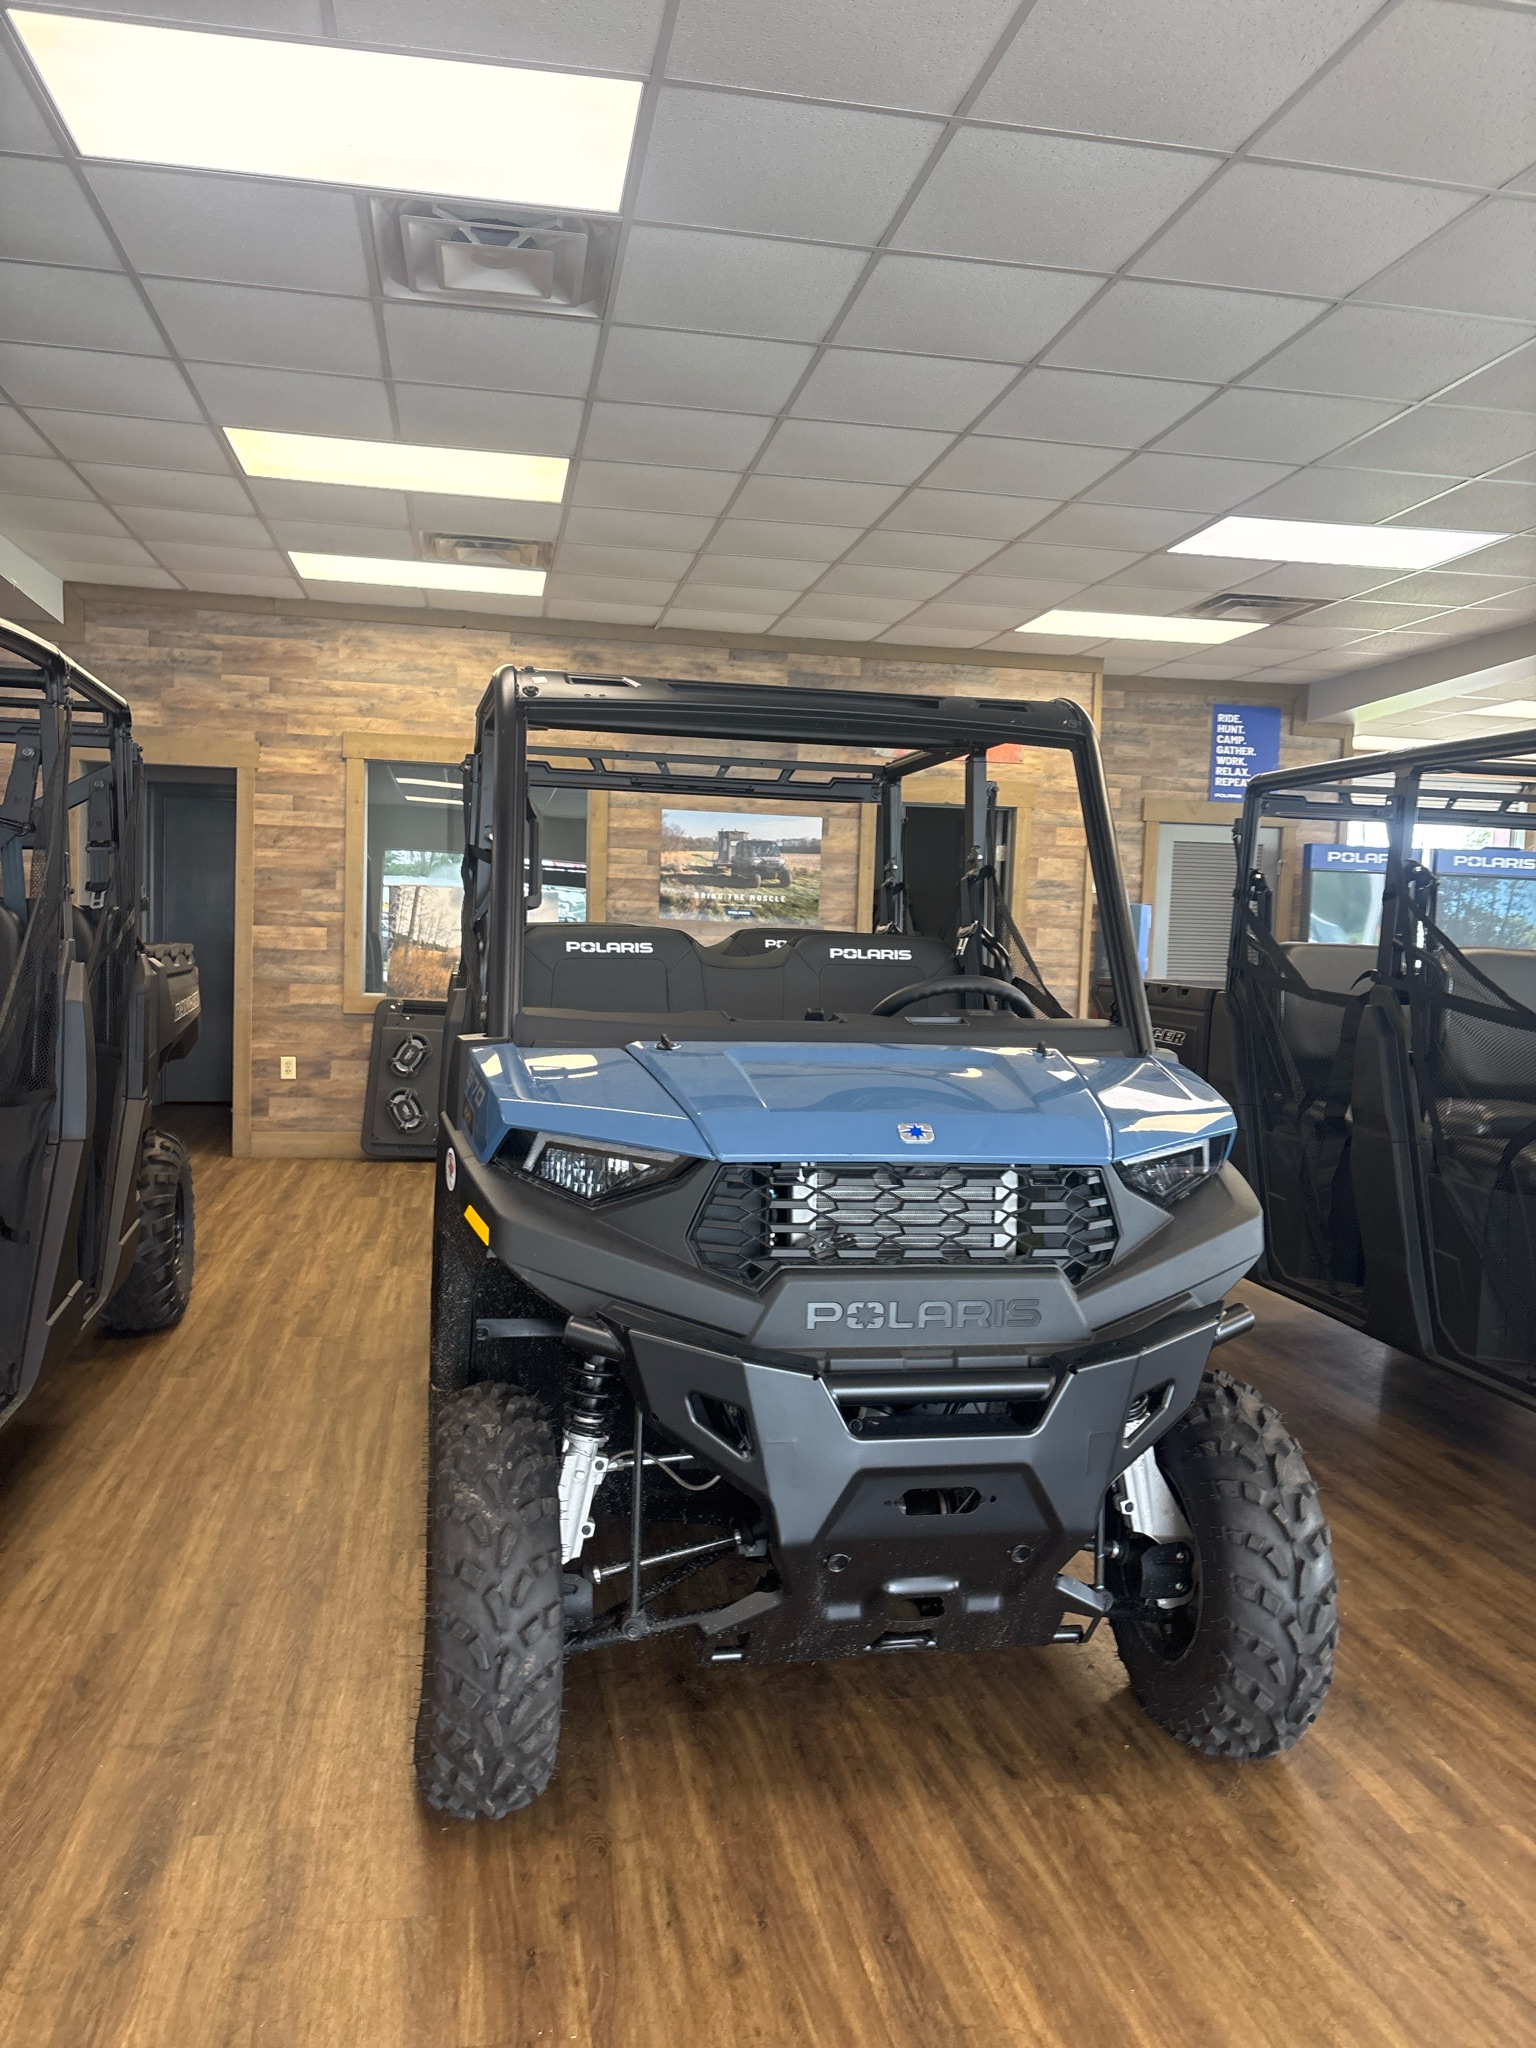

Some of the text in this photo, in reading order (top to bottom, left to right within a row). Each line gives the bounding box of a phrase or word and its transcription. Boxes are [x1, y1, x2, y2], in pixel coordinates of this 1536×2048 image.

[1217, 714, 1243, 723] RIDE.
[1217, 724, 1245, 734] HUNT.
[1216, 735, 1247, 744] CAMP.
[1216, 745, 1257, 756] GATHER.
[1215, 756, 1247, 766] WORK.
[1215, 766, 1251, 777] RELAX.
[1453, 855, 1536, 870] POLARIS
[694, 891, 787, 903] BRING THE MUSCLE
[565, 941, 654, 954] POLARIS
[829, 947, 913, 960] POLARIS
[805, 1298, 1042, 1331] POLARIS
